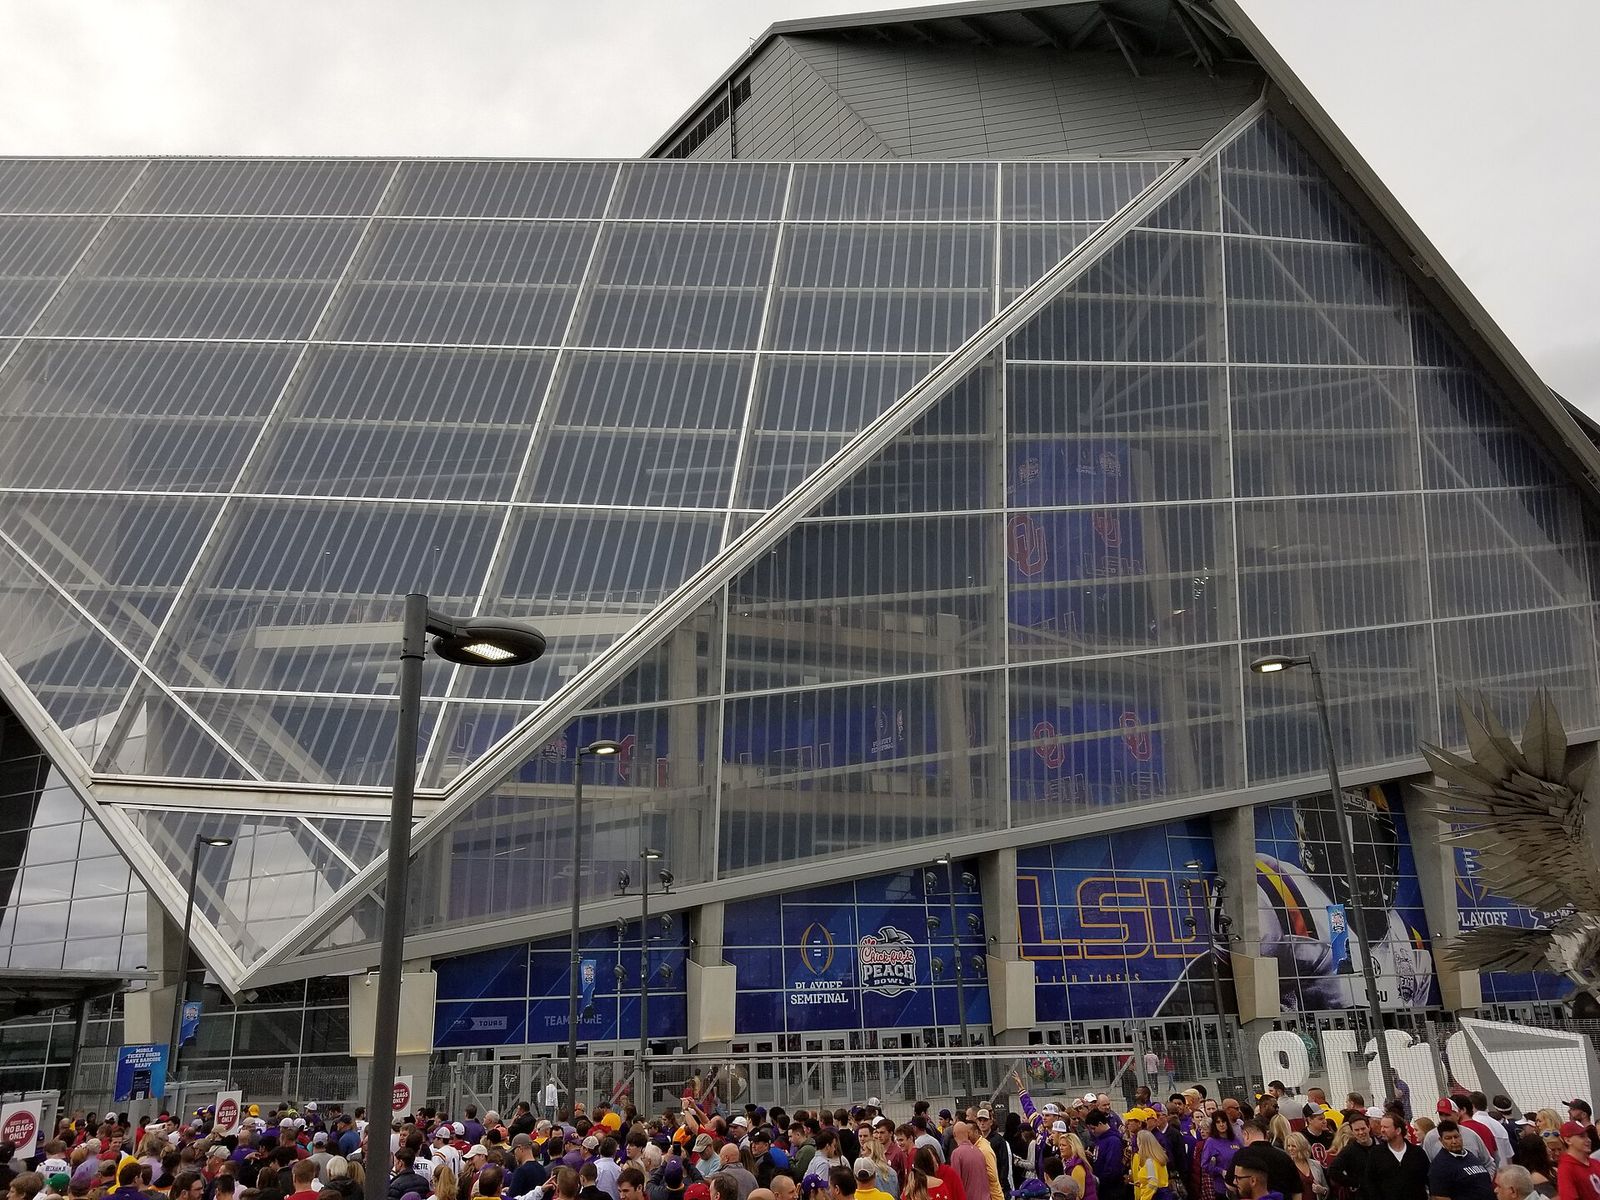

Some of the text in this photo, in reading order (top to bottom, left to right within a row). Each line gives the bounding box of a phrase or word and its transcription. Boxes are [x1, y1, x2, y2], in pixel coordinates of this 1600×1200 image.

[1017, 876, 1212, 960] LSU
[863, 964, 915, 981] PEACH
[1089, 973, 1140, 983] TIGERS
[790, 993, 849, 1005] SEMIFINAL
[544, 1015, 570, 1027] TEAM
[4, 1123, 34, 1134] NO BAGS
[9, 1131, 28, 1141] ONLY
